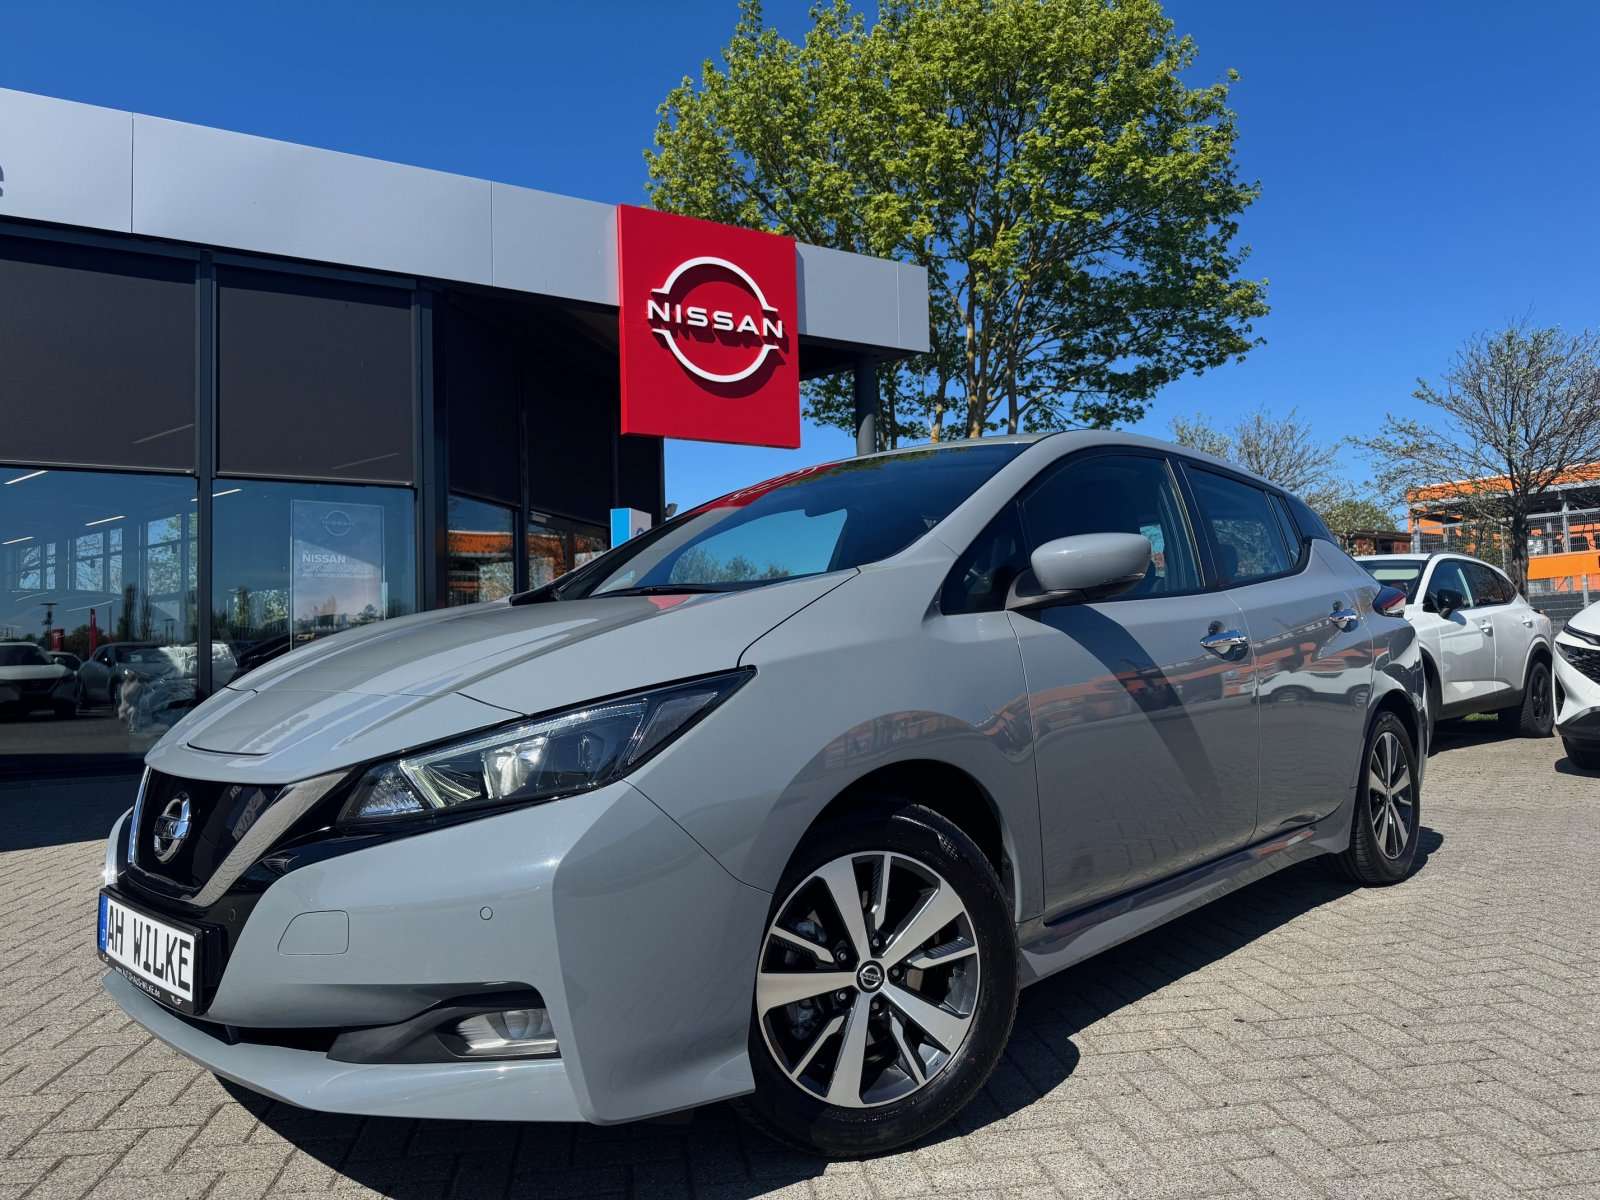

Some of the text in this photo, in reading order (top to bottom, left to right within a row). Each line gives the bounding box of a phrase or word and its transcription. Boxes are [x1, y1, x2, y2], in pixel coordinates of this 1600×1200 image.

[647, 299, 783, 338] NISSAN
[302, 553, 346, 564] NISSAN
[107, 904, 124, 956] AH
[133, 917, 191, 993] WILKE
